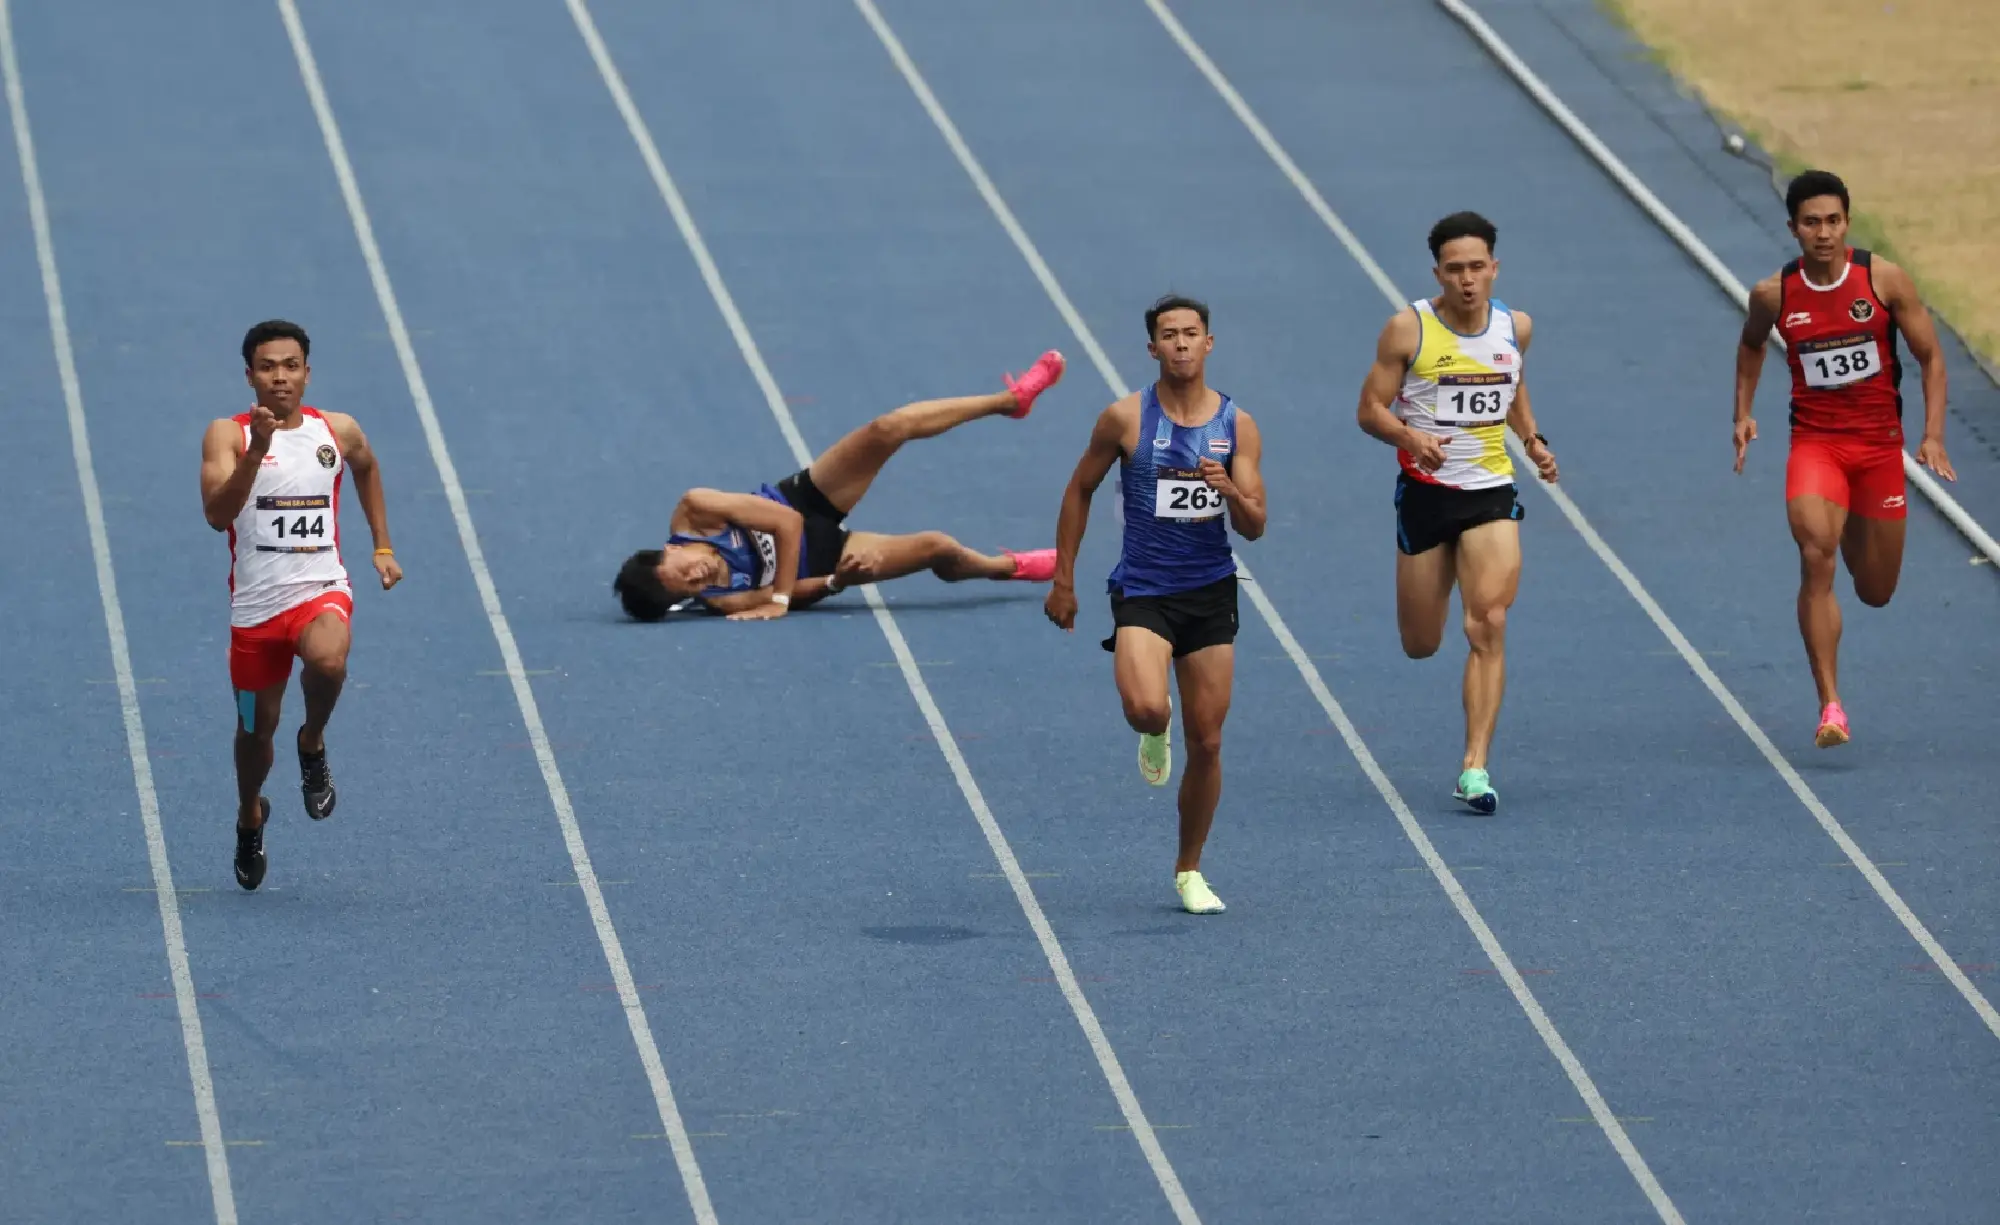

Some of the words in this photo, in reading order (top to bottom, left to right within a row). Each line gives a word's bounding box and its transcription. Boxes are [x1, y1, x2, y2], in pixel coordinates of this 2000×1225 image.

[1815, 350, 1869, 378] 138
[1451, 391, 1501, 414] 163
[1169, 487, 1222, 510] 263
[271, 515, 324, 538] 144
